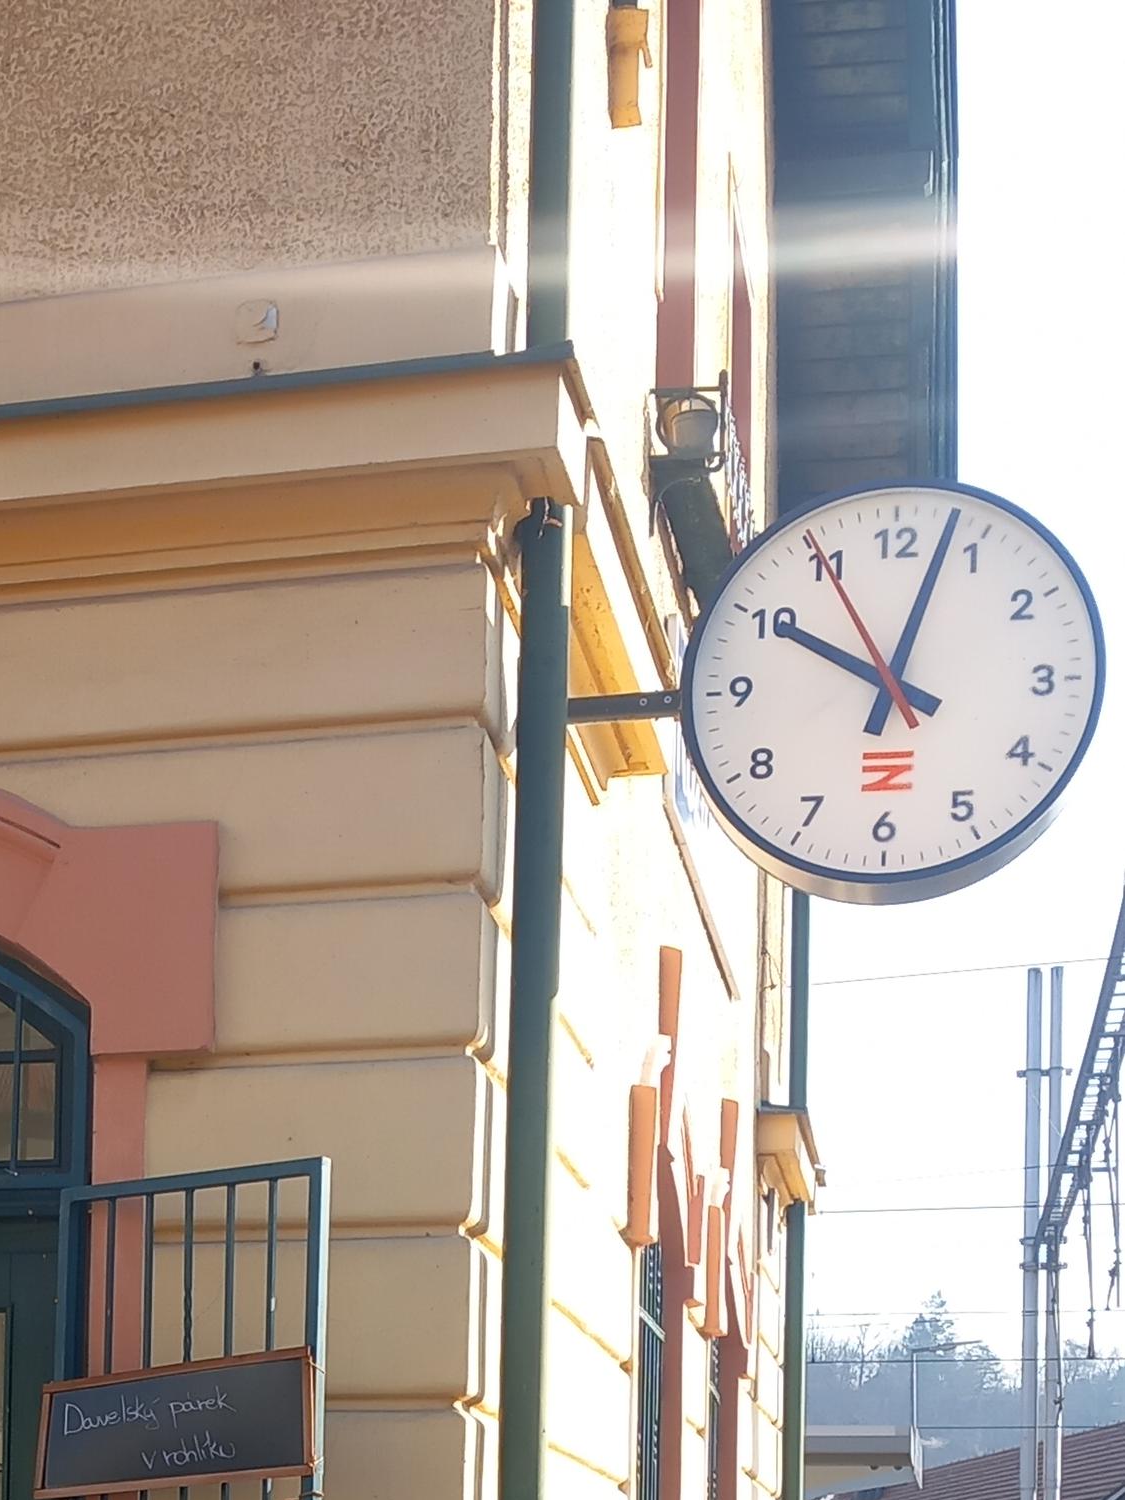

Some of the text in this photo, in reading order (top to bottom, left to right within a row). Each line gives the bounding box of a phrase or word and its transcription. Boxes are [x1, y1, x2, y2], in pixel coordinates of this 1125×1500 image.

[874, 527, 918, 559] 12
[963, 543, 978, 574] 1
[808, 550, 844, 582] 11
[1010, 590, 1034, 621] 2
[752, 606, 797, 639] 10
[729, 676, 753, 707] 9
[1031, 664, 1055, 696] 3
[749, 748, 774, 779] 8
[1006, 736, 1035, 767] 4
[800, 795, 825, 827] 7
[950, 790, 974, 822] 5
[872, 811, 896, 842] 6
